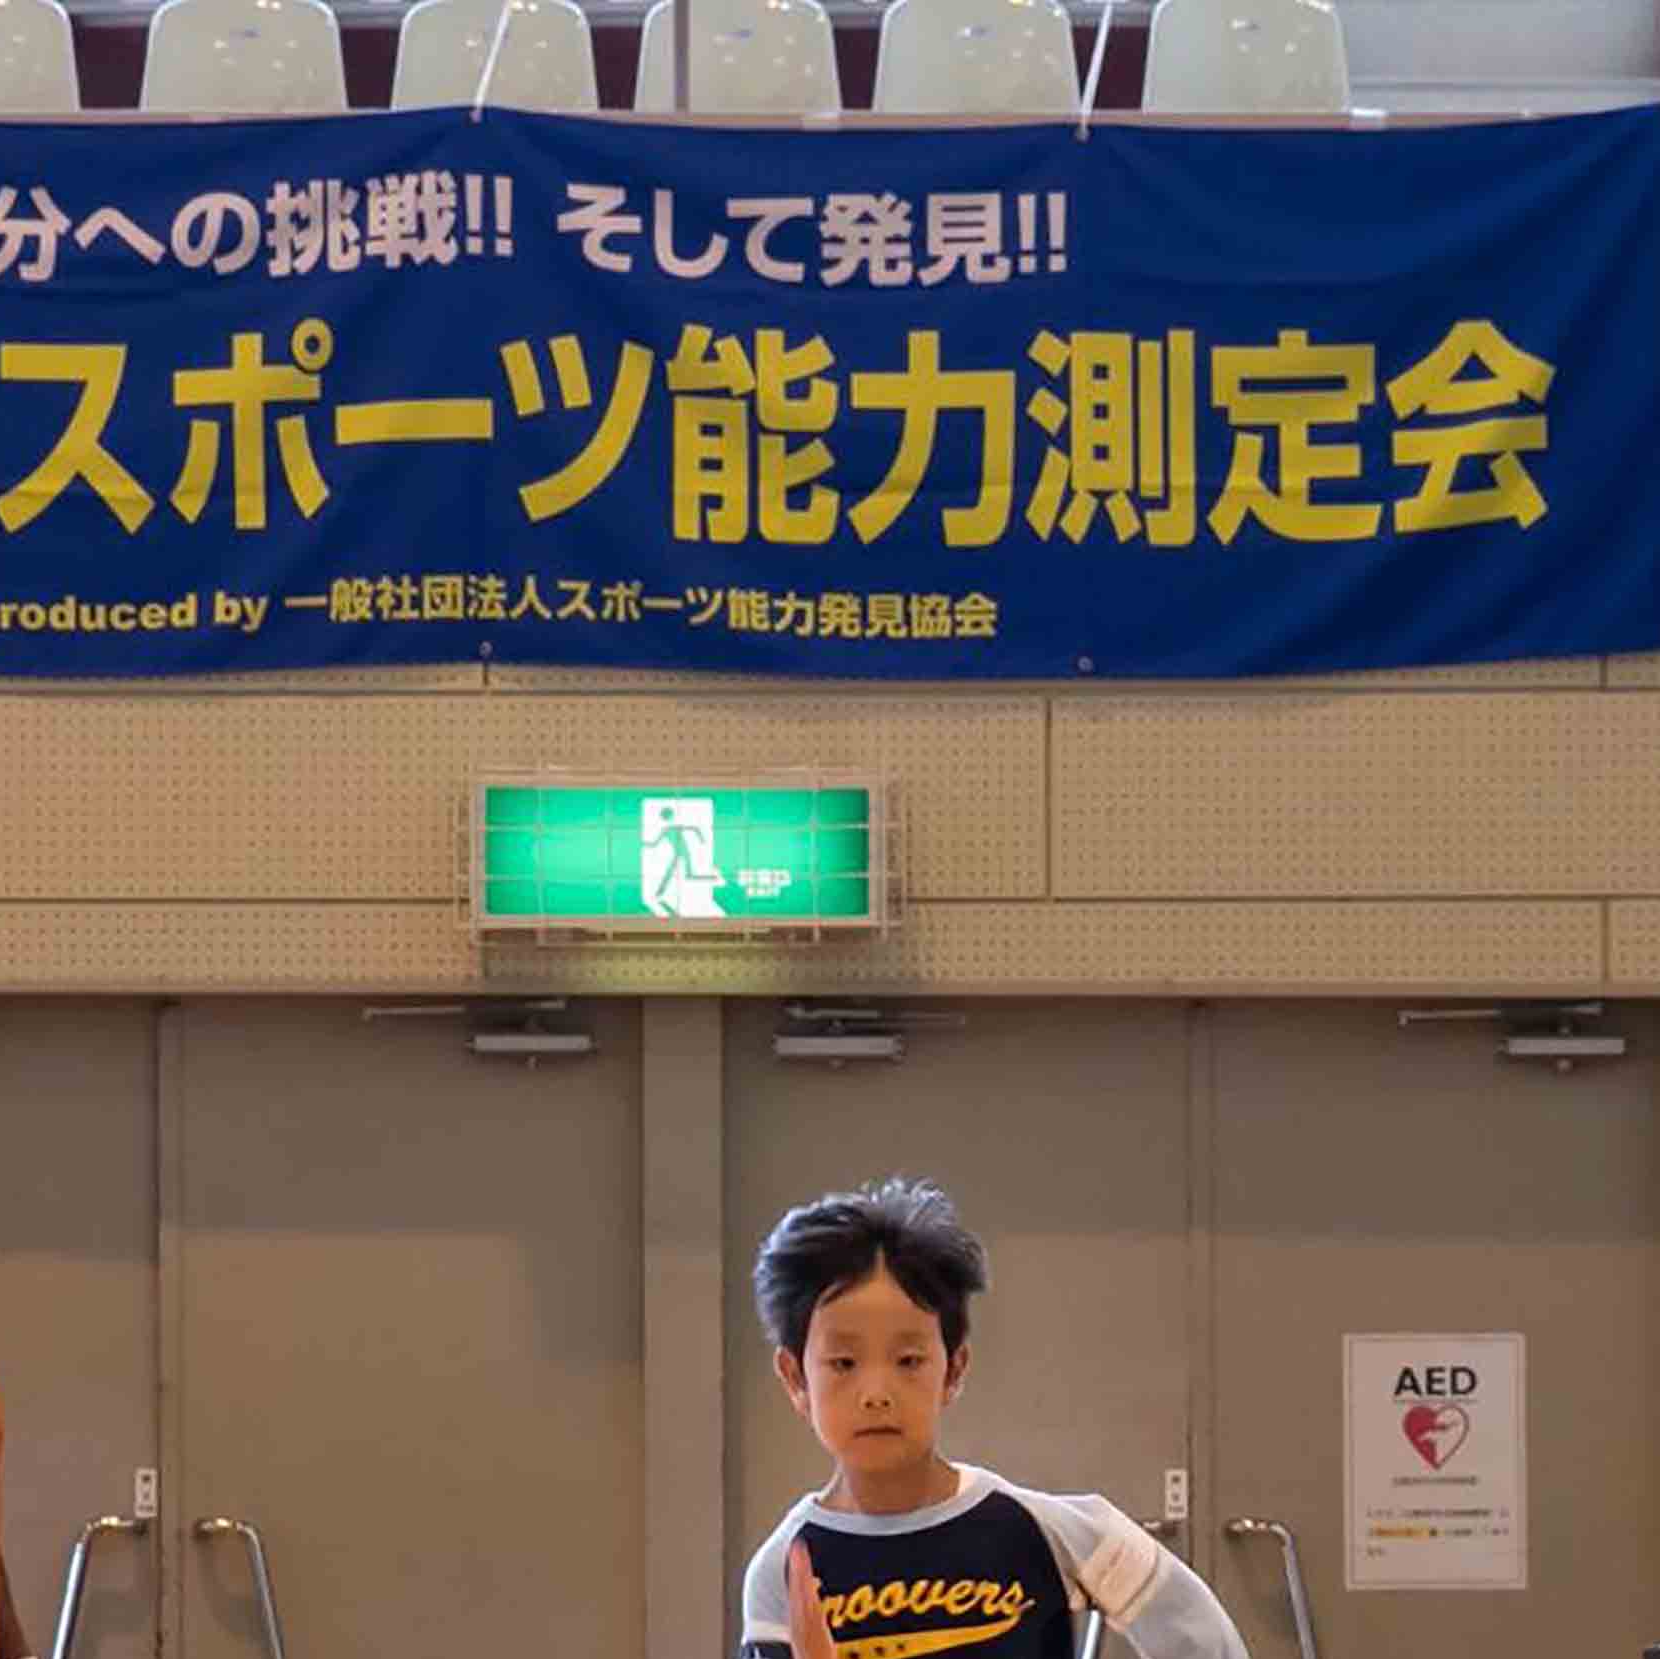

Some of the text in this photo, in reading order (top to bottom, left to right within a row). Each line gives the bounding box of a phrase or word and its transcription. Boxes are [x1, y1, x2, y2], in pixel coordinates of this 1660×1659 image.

[556, 182, 1068, 287] そして発見!!
[214, 590, 268, 632] by
[284, 575, 998, 639] 一般社団法人スポーツ能力発見協会
[1394, 1366, 1477, 1396] AED
